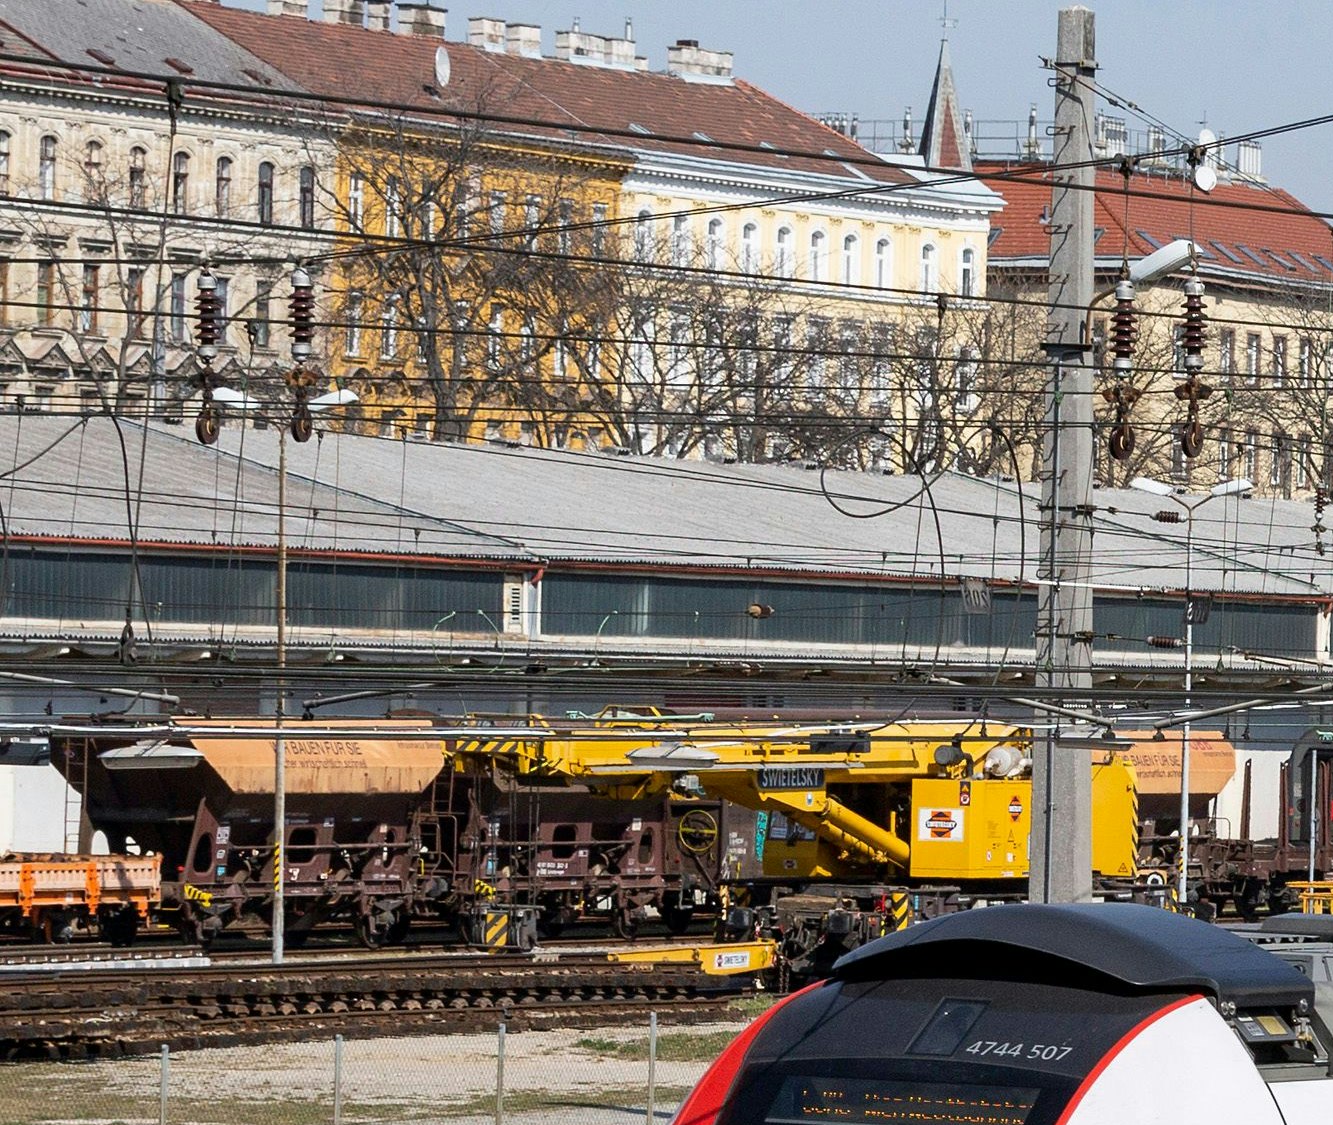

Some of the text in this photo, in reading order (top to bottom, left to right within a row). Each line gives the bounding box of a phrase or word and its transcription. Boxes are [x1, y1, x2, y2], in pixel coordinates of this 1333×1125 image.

[294, 742, 325, 755] BAUEN
[346, 742, 363, 755] SIE
[762, 768, 819, 787] SWIETELSKY
[966, 1041, 1072, 1061] 4744 507
